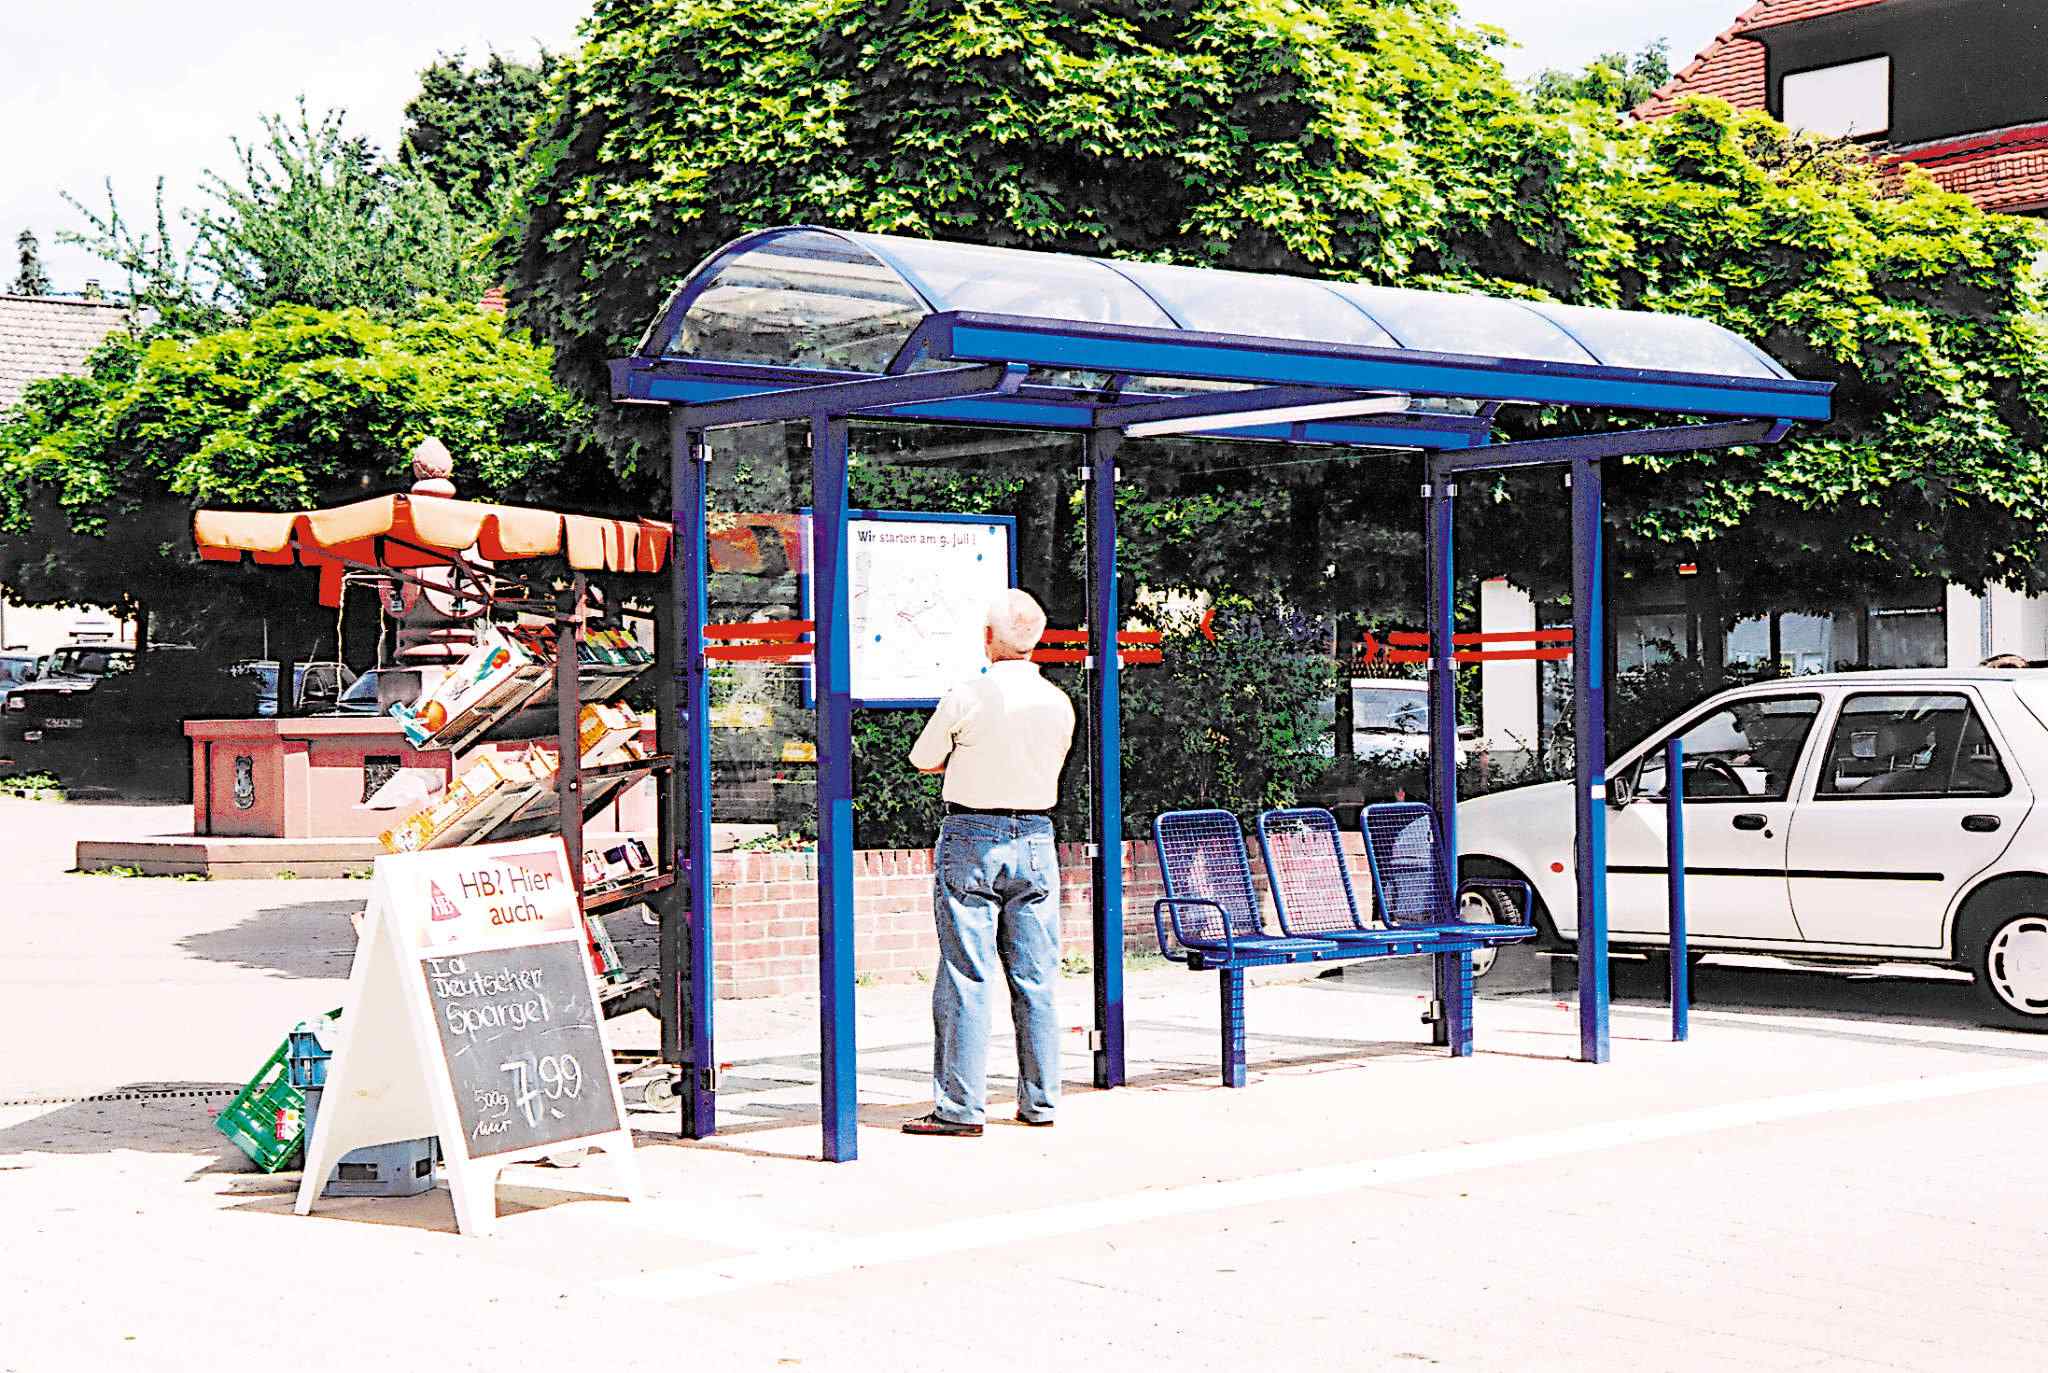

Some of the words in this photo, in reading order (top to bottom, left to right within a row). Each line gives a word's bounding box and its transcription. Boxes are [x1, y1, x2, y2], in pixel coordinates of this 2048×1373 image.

[857, 530, 876, 542] Wir
[880, 533, 917, 544] starten
[920, 534, 937, 544] am
[459, 870, 503, 898] HB?
[507, 866, 552, 893] Hier
[489, 896, 544, 926] auch.
[445, 993, 551, 1042] Spargel
